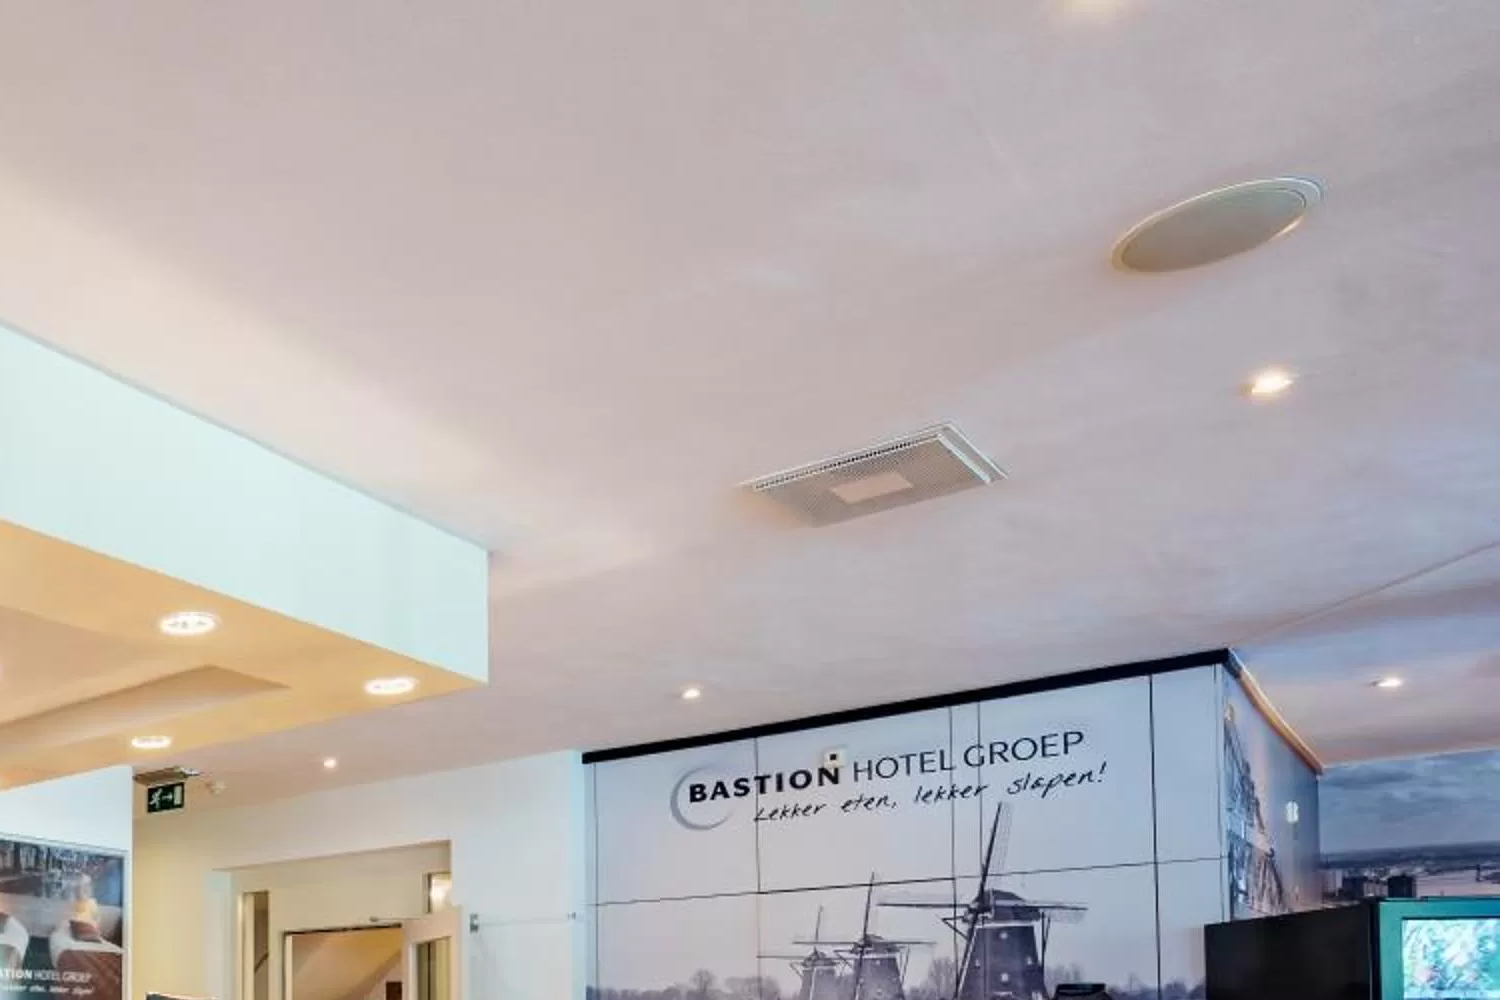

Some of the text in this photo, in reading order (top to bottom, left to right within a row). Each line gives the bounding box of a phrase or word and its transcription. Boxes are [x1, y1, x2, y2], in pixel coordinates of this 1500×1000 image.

[688, 731, 1085, 804] BASTION HOTEL GROEP
[840, 792, 898, 813] eten,
[913, 783, 989, 804] lekker
[1006, 761, 1108, 799] slapen!
